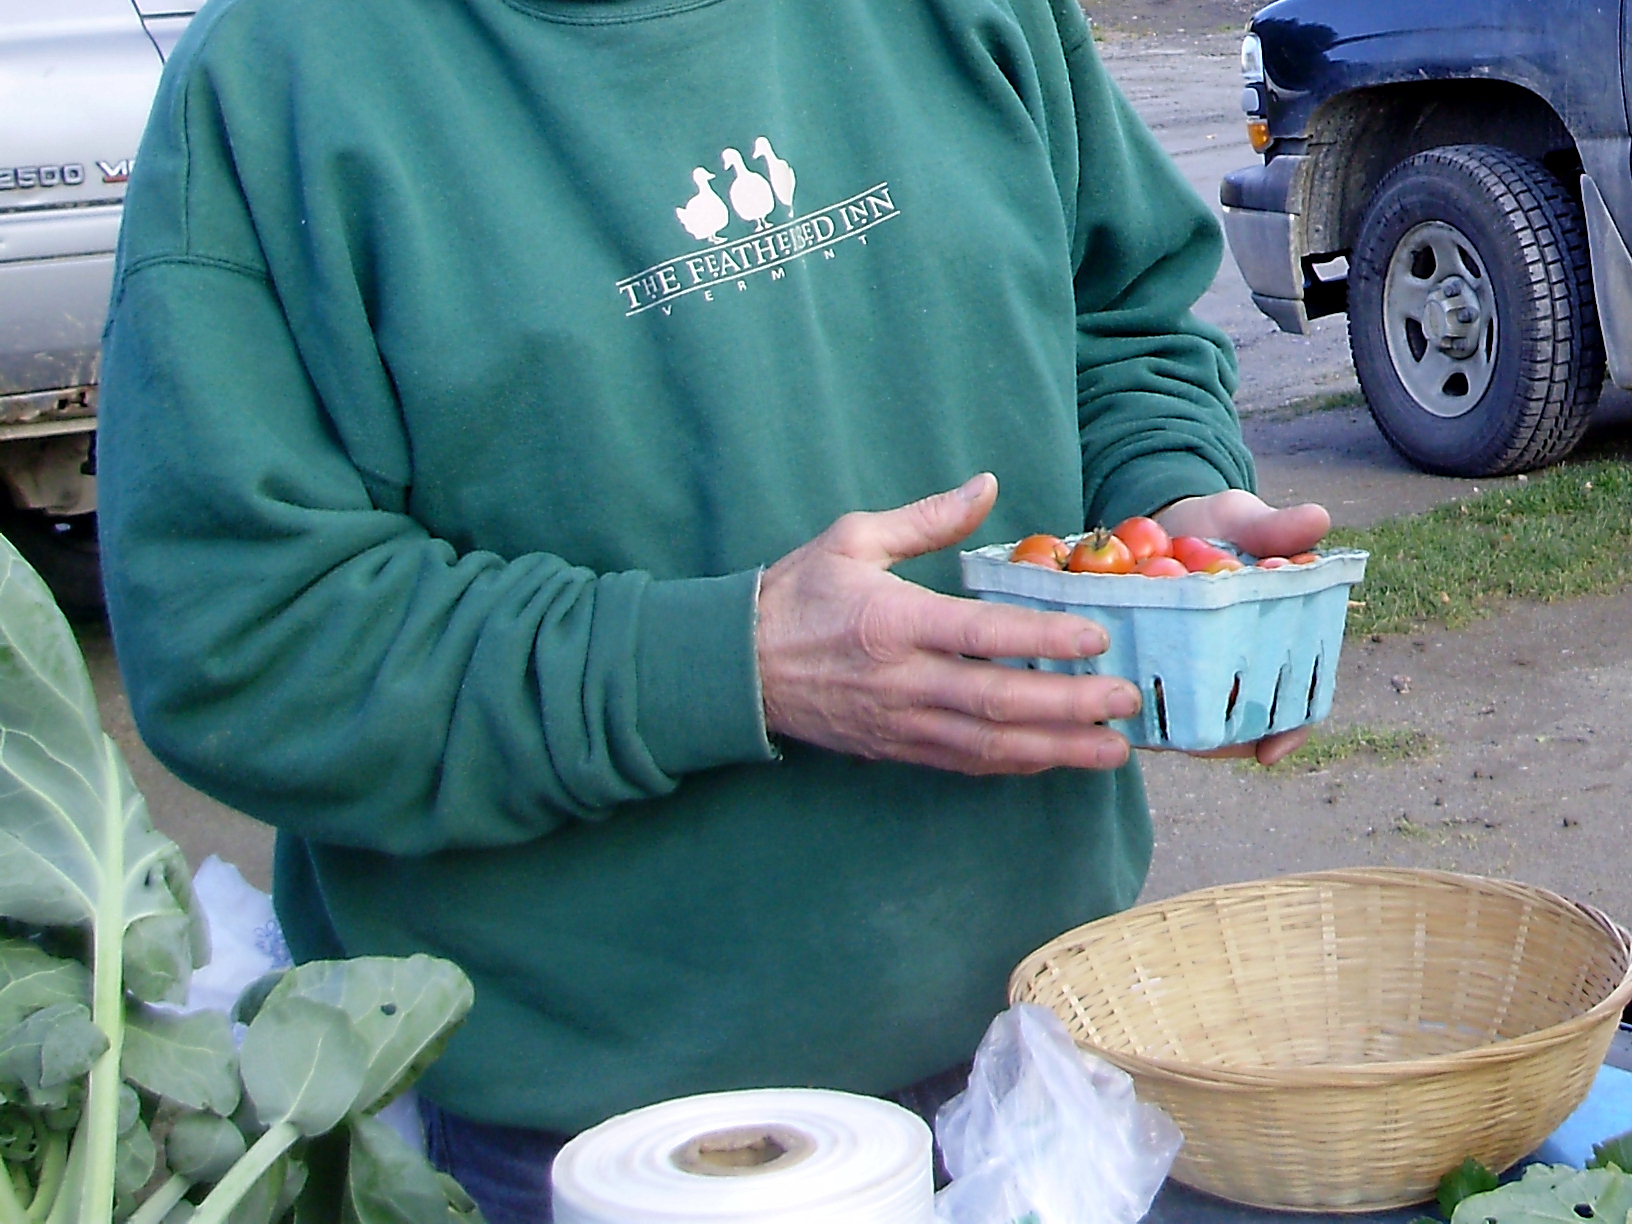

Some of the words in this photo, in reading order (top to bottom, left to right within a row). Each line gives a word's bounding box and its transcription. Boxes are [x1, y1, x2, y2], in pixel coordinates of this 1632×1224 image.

[619, 265, 681, 310] THE
[684, 216, 835, 283] FEATHEBED
[841, 187, 897, 232] INN
[661, 234, 869, 317] VERMNT
